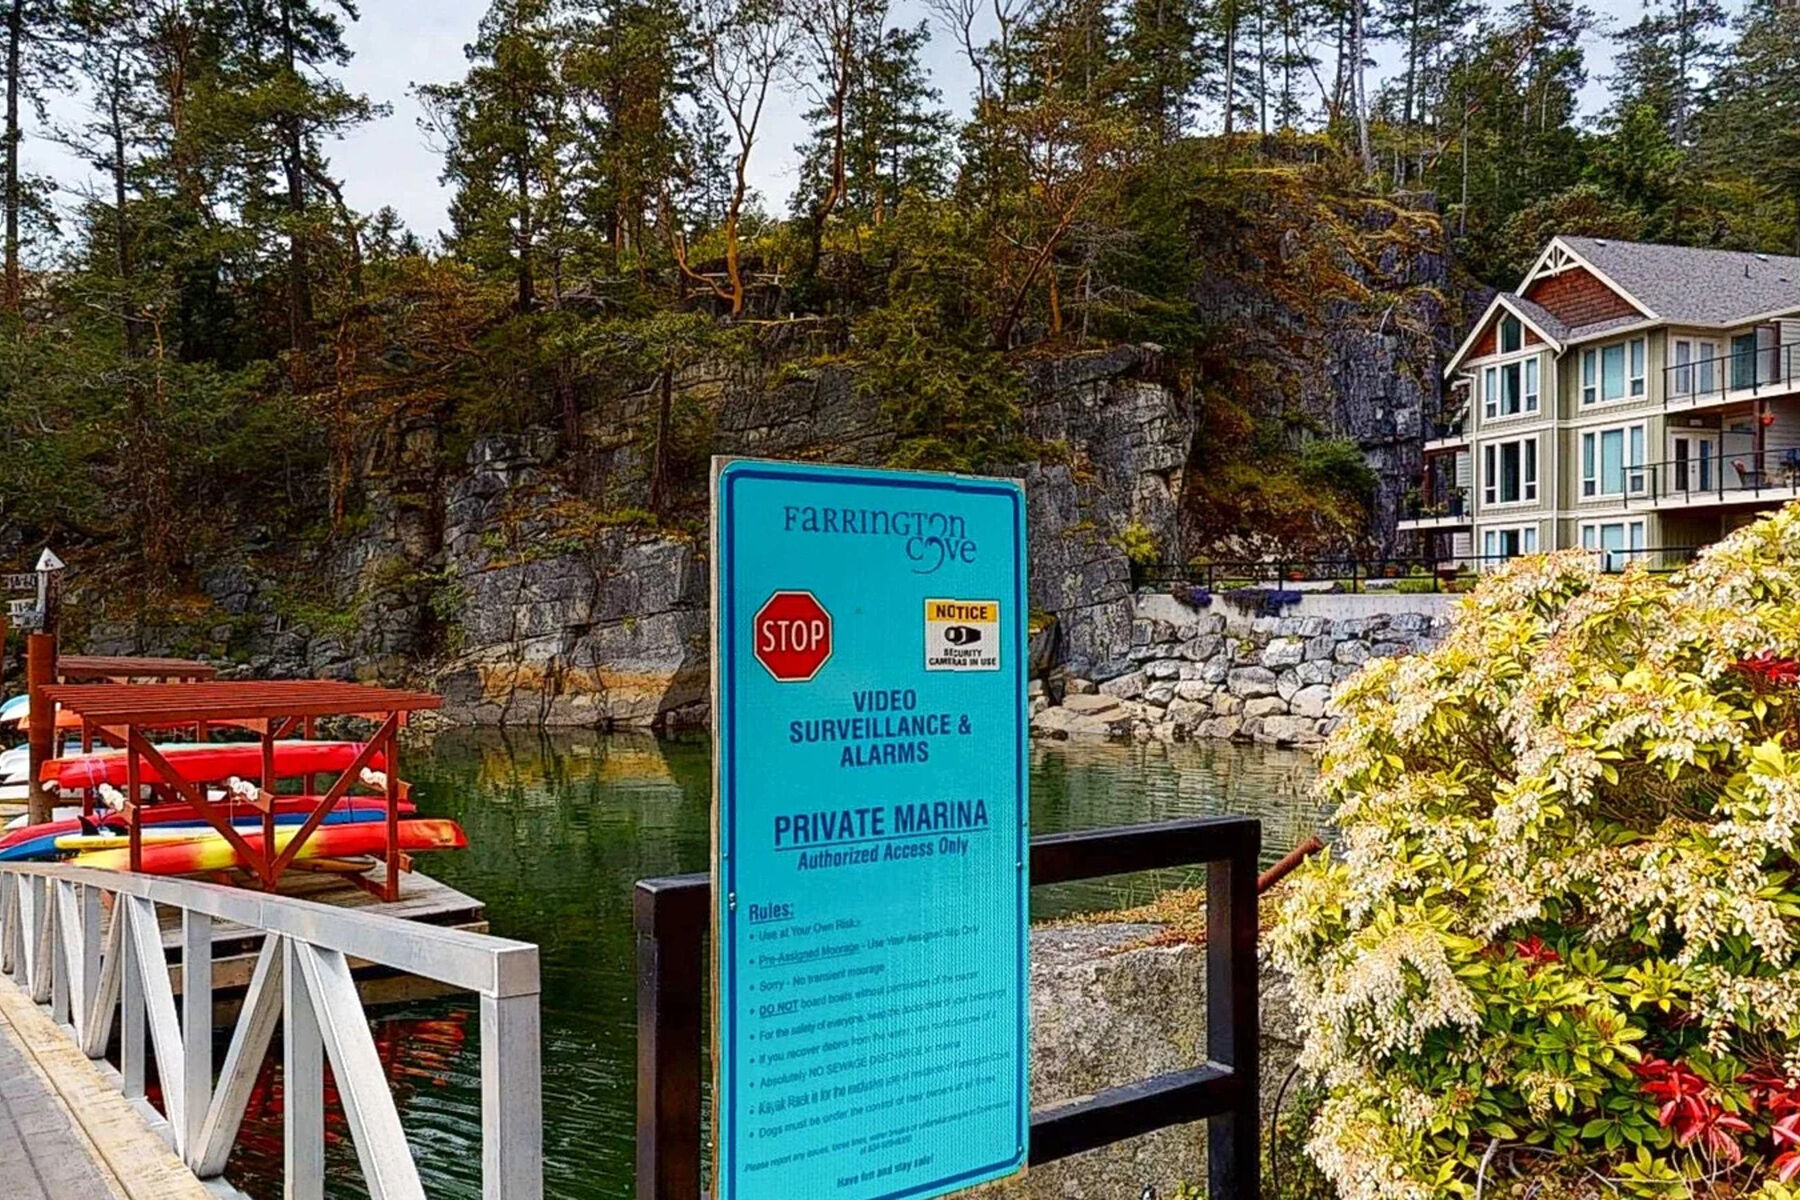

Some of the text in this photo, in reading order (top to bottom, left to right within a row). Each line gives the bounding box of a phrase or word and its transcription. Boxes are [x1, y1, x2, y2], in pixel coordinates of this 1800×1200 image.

[936, 605, 988, 619] NOTICE
[762, 620, 824, 652] STOP
[929, 658, 967, 666] CAMERAS
[853, 690, 917, 712] VIDEO
[790, 714, 972, 743] SURVEILLANCE &
[840, 741, 929, 767] ALARMS
[775, 799, 988, 846] PRIVATE MARINA
[797, 837, 969, 871] Authorized Access Only
[749, 902, 794, 921] Rules:
[759, 930, 777, 940] Use
[792, 925, 811, 936] Your
[814, 923, 834, 933] Own
[760, 979, 784, 992] Sorry
[793, 976, 805, 986] No
[759, 1005, 775, 1016] DO
[778, 999, 798, 1013] NOT
[760, 1030, 774, 1041] For
[767, 1051, 785, 1065] you
[760, 1070, 807, 1088] Absolutely
[809, 1067, 824, 1078] NO
[826, 1057, 868, 1075] SEWAGE
[759, 1126, 782, 1138] Dogs
[785, 1119, 808, 1132] must
[822, 1110, 848, 1124] under
[837, 1175, 859, 1188] Have
